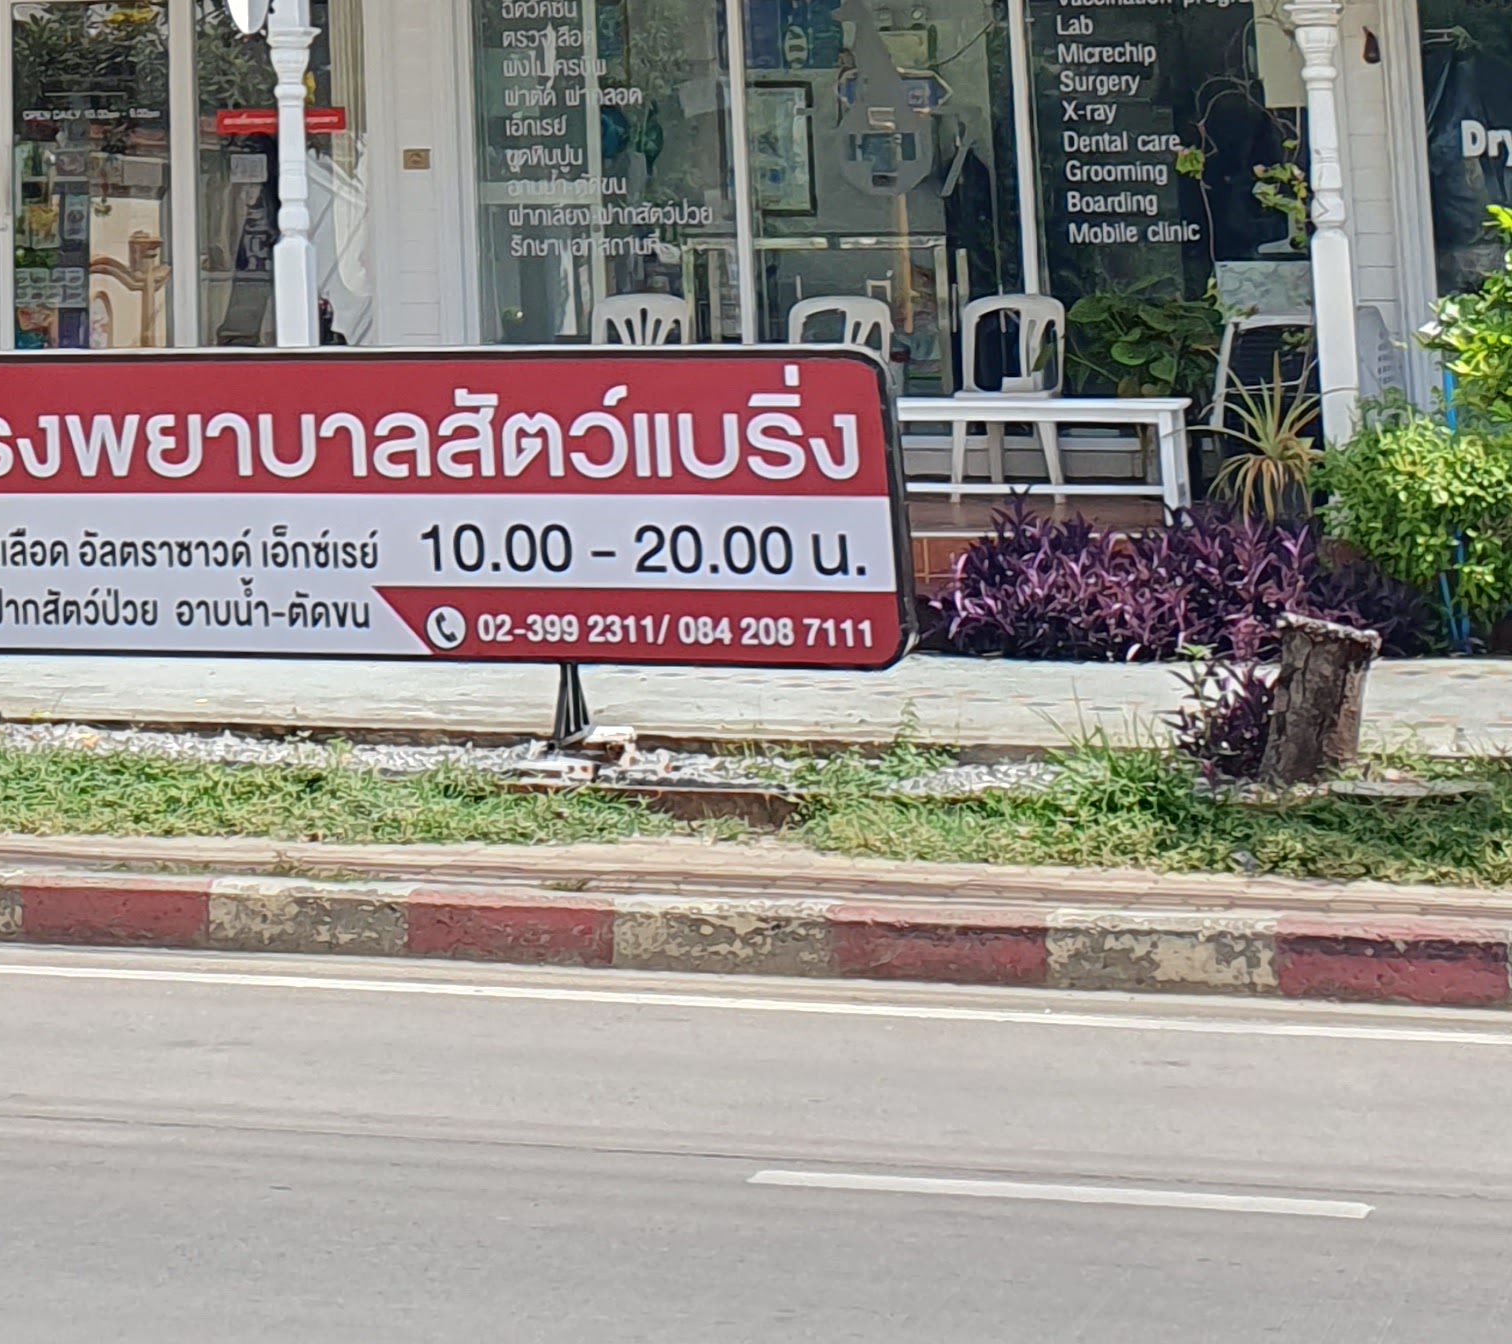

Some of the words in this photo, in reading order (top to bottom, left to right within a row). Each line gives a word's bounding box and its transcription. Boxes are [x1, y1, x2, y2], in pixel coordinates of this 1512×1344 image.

[1056, 14, 1094, 35] Lab
[1059, 70, 1141, 96] Surgery
[1062, 100, 1117, 124] X-ray
[1062, 130, 1128, 153] Dental
[1137, 133, 1181, 152] care
[1065, 159, 1168, 185] Grooming
[1066, 191, 1158, 216] Boarding
[1068, 222, 1138, 244] Mobile
[1147, 220, 1201, 242] clinic
[79, 528, 252, 568] อัลตราซาวด์
[261, 524, 379, 570] เอ็กซ์เรย์
[420, 522, 574, 574] 10.00
[634, 524, 794, 577] 20.00
[811, 530, 868, 577] น.
[175, 577, 371, 630] อาบน้ำ-ตัดขน
[476, 613, 580, 644] 02-399
[586, 615, 670, 648] 2311/
[677, 616, 733, 647] 084
[739, 617, 795, 648] 208
[802, 618, 874, 649] 7111
